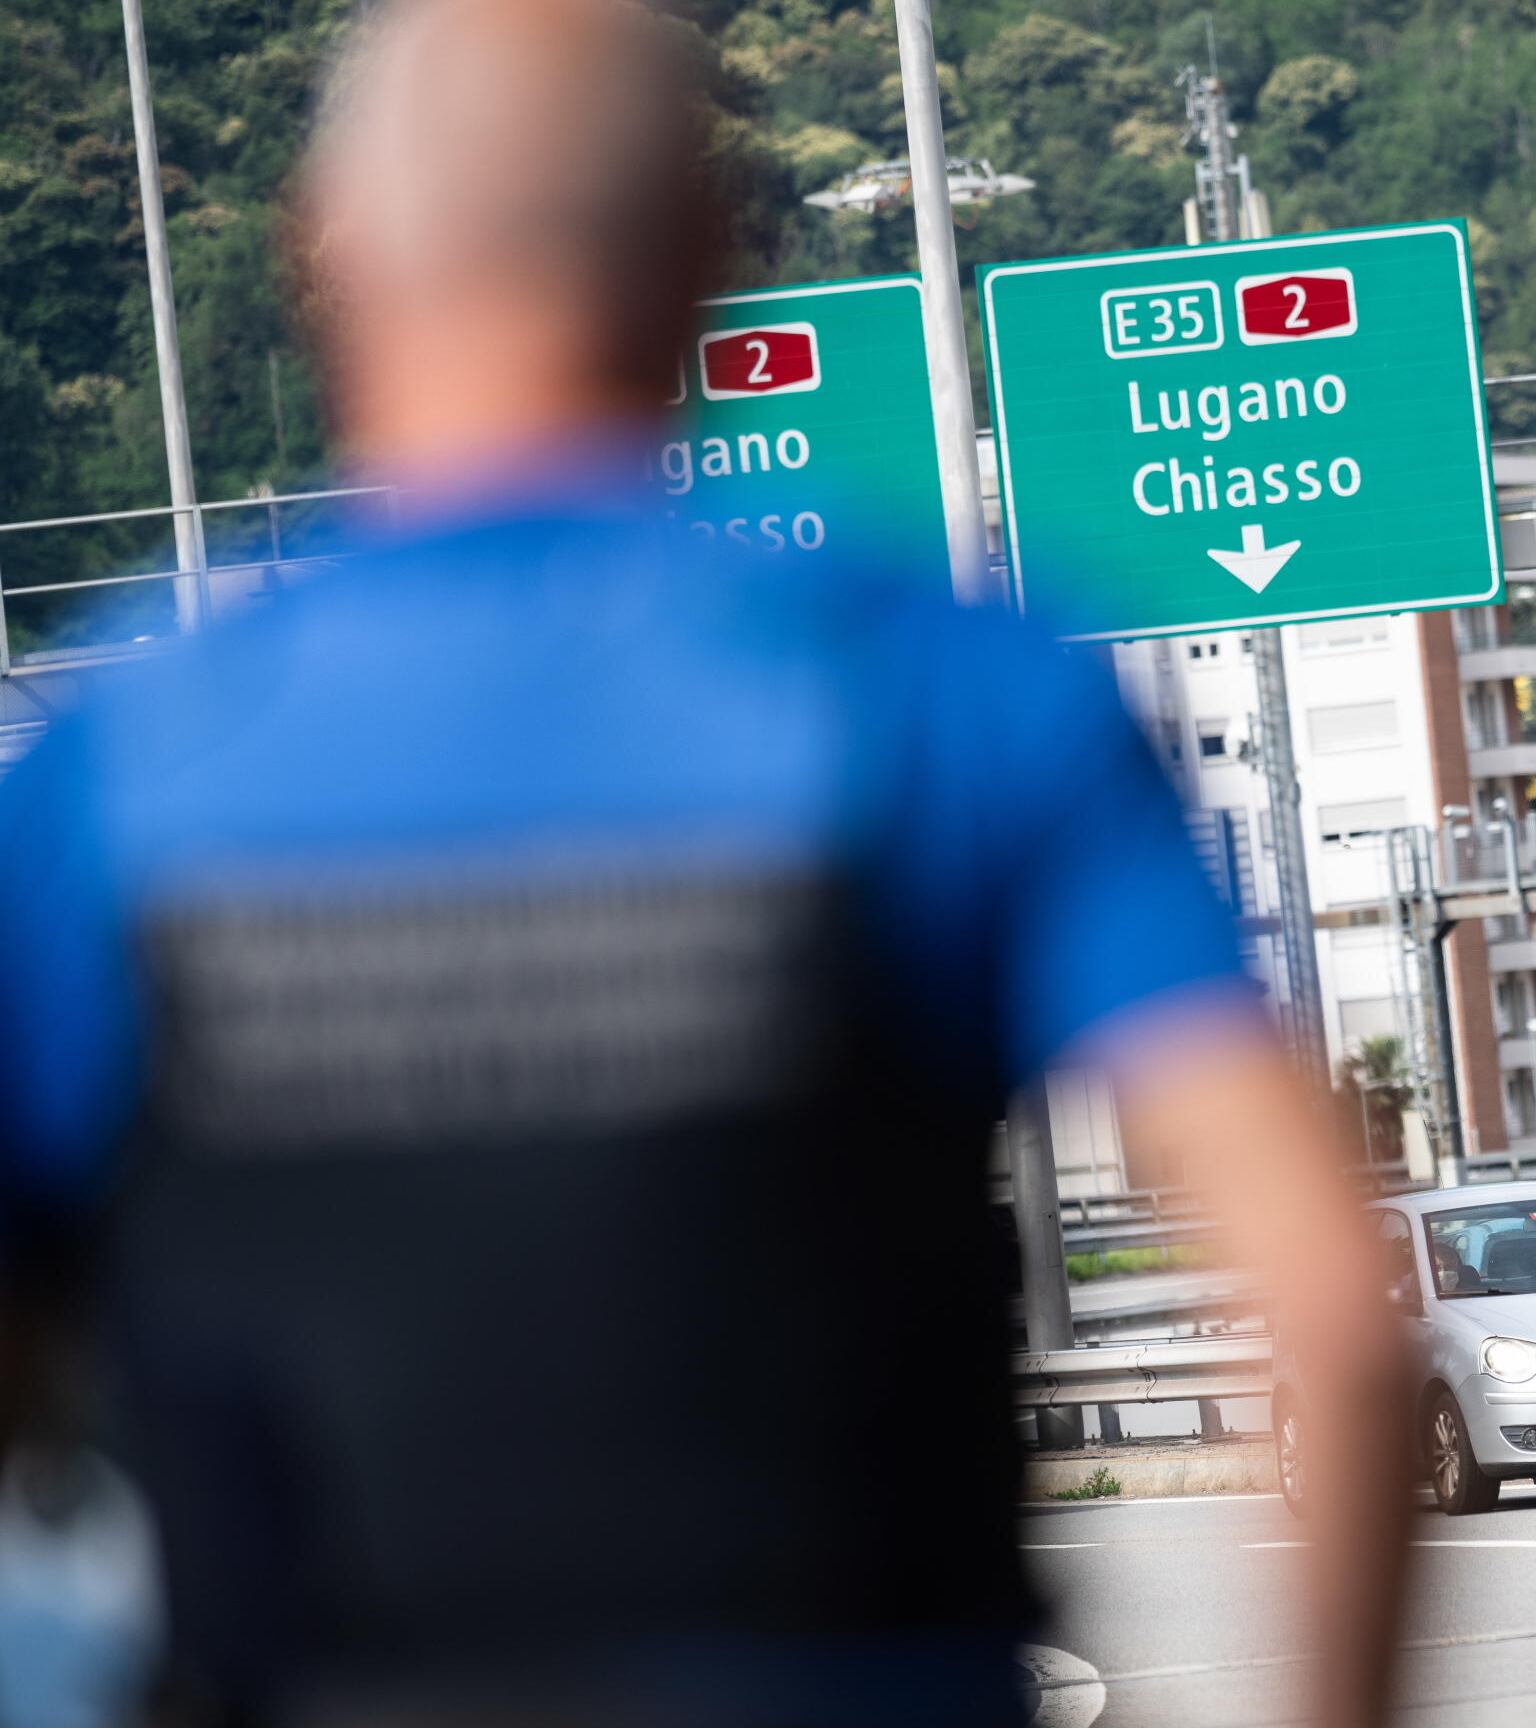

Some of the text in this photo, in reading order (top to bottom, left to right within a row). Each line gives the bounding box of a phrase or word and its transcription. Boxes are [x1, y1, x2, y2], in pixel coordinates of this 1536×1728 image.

[1282, 284, 1310, 330] 2
[745, 339, 773, 384] 2
[1128, 374, 1347, 442] Lugano
[648, 428, 810, 496] gano
[1132, 456, 1362, 517] Chiasso
